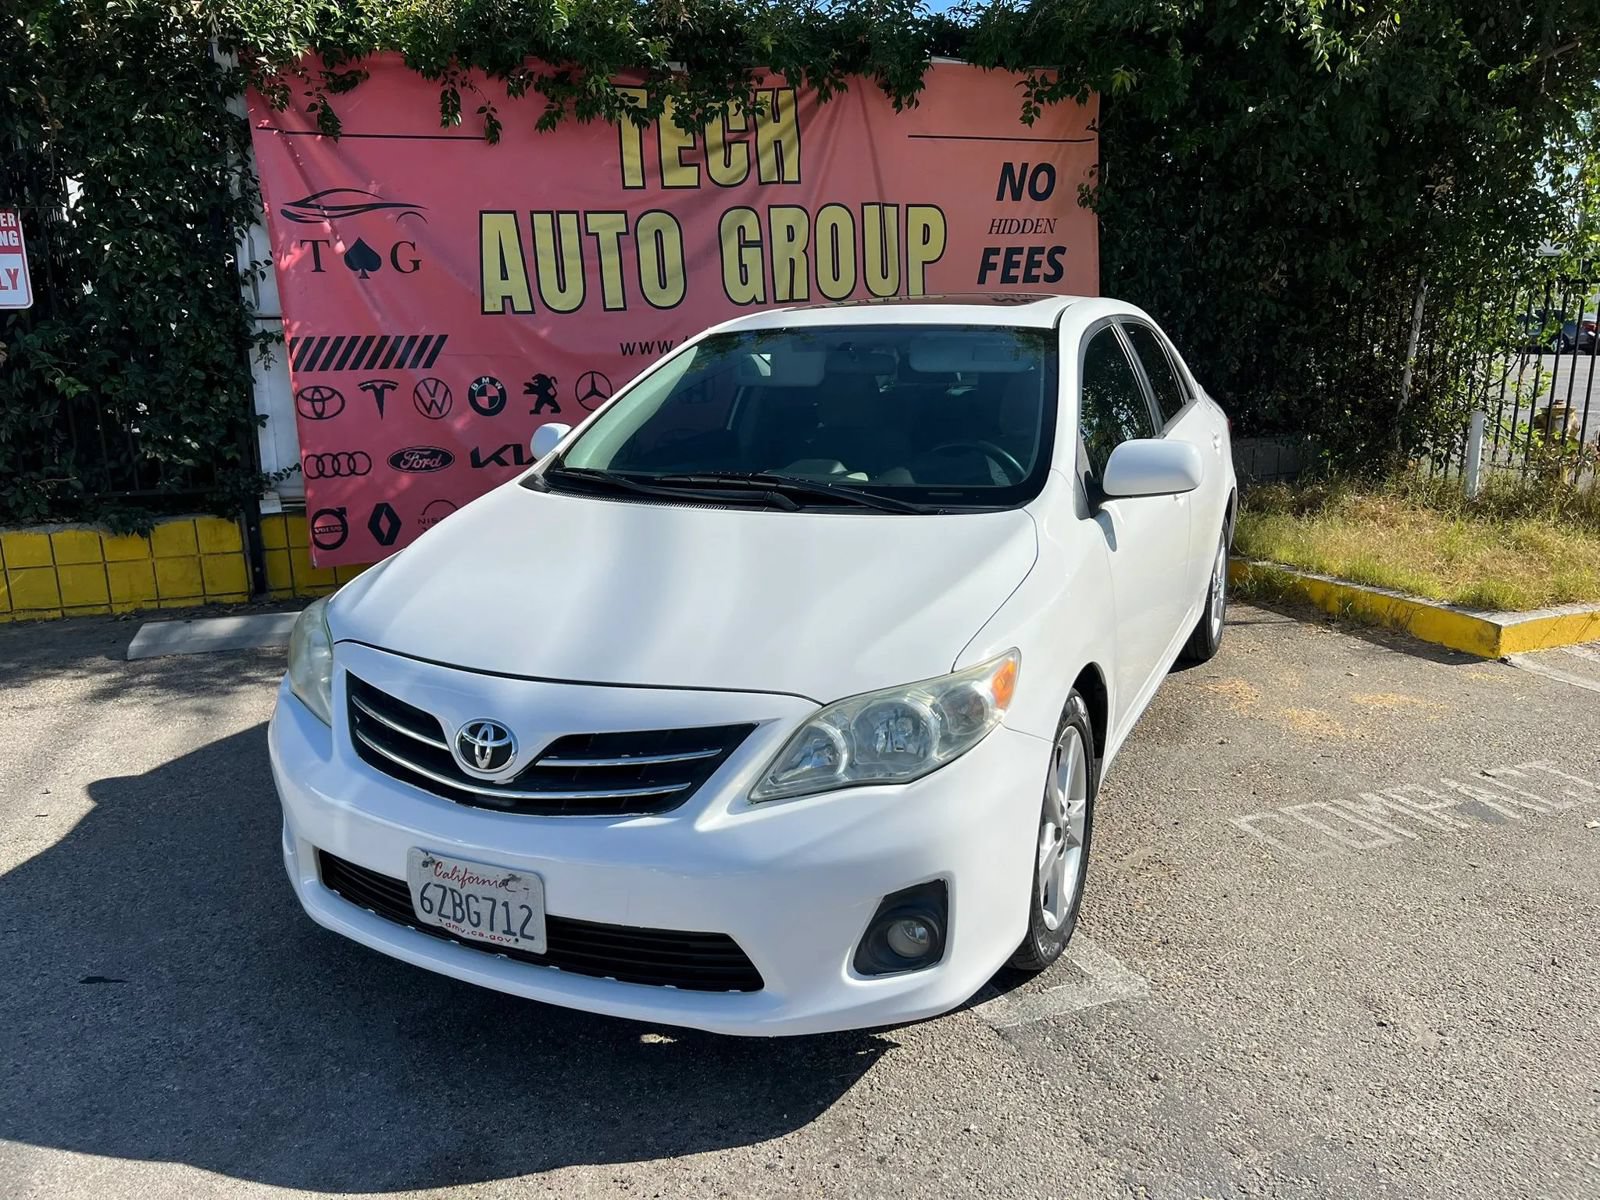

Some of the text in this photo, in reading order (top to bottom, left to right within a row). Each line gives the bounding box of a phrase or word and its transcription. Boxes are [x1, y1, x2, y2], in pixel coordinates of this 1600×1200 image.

[612, 85, 801, 189] TECH
[996, 161, 1057, 202] NO
[987, 217, 1058, 235] HIDDEN
[479, 202, 948, 314] AUTO GROUP
[977, 245, 1067, 285] FEES
[400, 449, 442, 469] Ford
[433, 860, 516, 893] California
[419, 882, 535, 941] 6ZBG712
[445, 921, 511, 943] dmv.ca.gov
